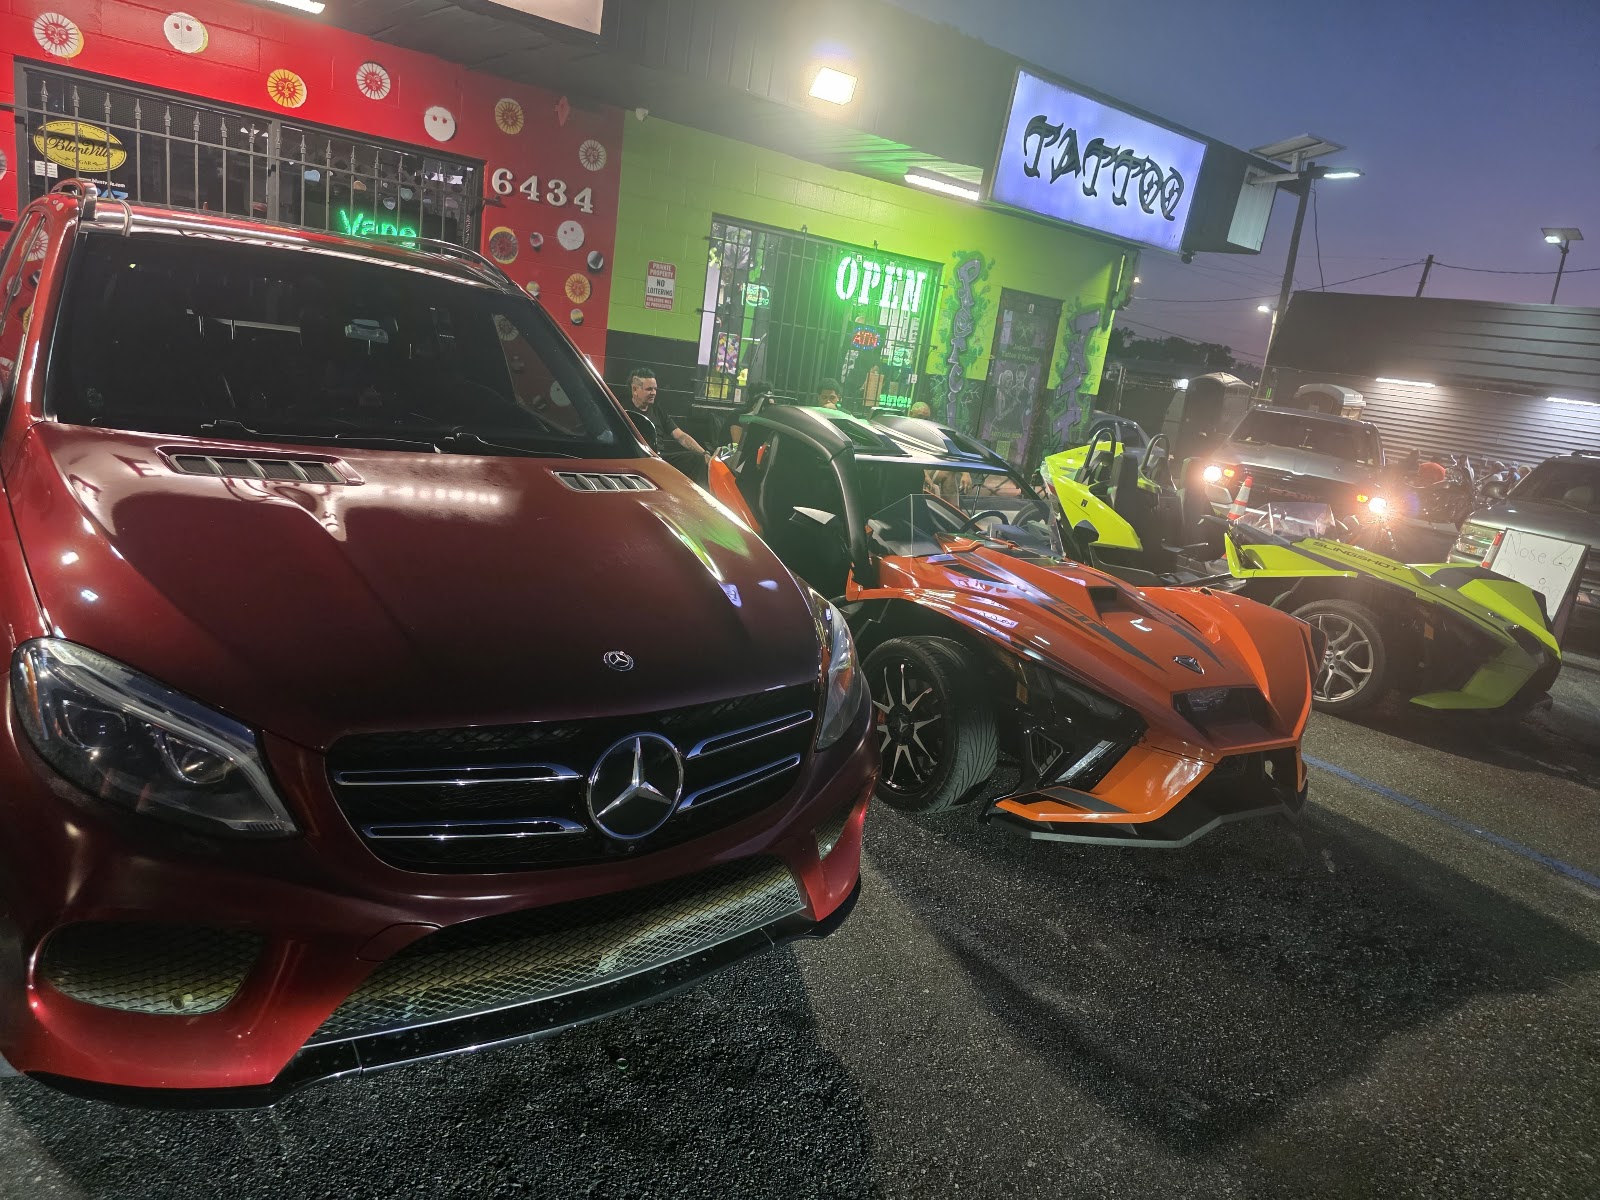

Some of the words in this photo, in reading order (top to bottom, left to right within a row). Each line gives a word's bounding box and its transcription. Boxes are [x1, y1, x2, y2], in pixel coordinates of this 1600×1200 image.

[72, 158, 92, 166] CGAR
[1024, 114, 1185, 222] TATTOO
[491, 168, 594, 214] 6434
[650, 269, 674, 278] PROPERTY
[653, 262, 672, 271] PRIVATE
[647, 287, 673, 296] LOITERING
[656, 279, 666, 287] NO
[835, 256, 927, 313] OPEN
[1312, 541, 1402, 572] SLINGSHOT
[1504, 533, 1547, 565] Nose
